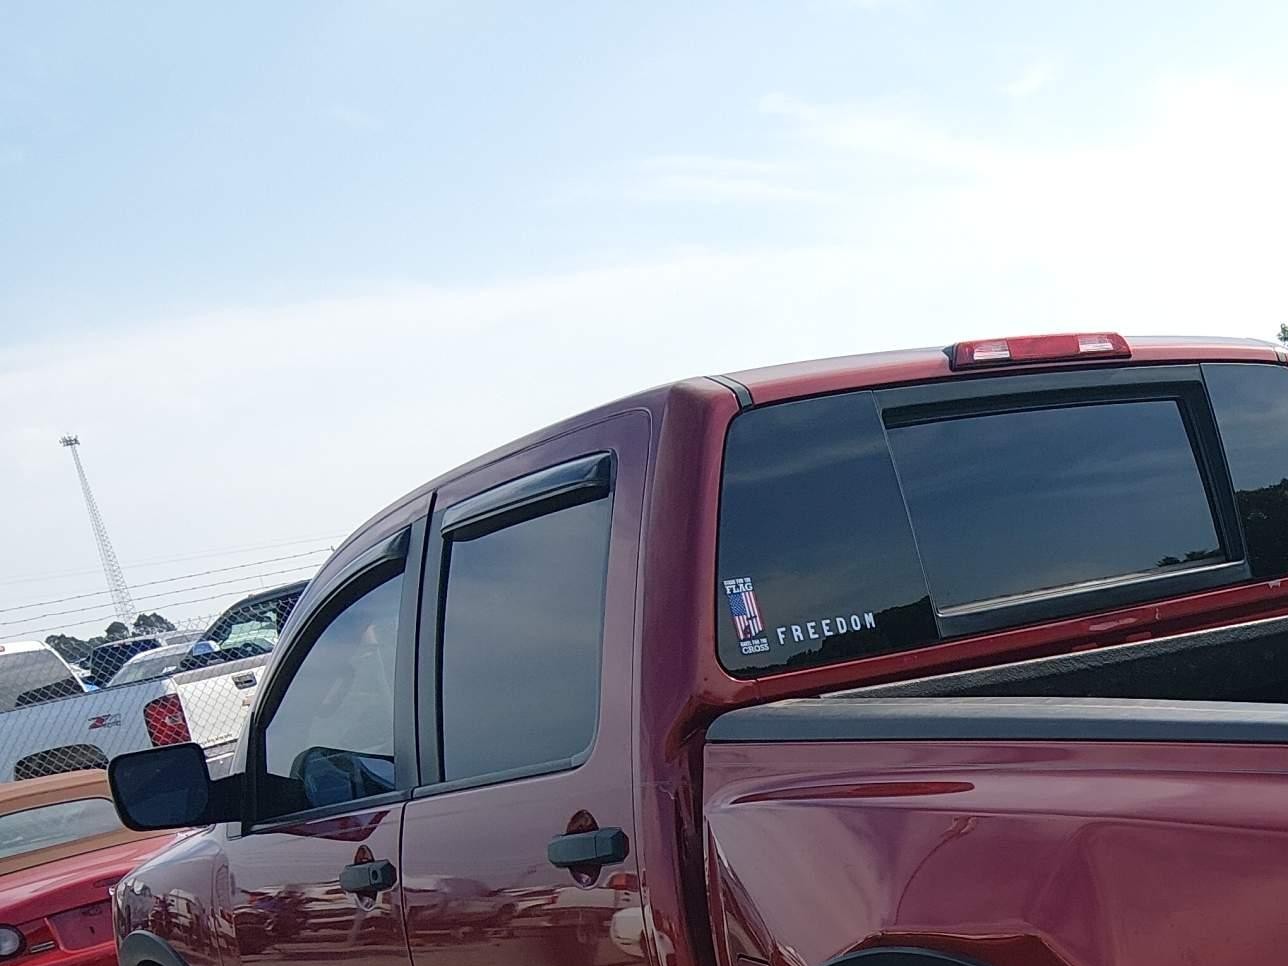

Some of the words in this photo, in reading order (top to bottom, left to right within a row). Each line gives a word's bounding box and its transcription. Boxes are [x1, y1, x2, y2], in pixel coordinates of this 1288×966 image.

[724, 582, 753, 595] FLAG
[776, 612, 877, 645] FREEDOM
[742, 643, 770, 655] CROSS
